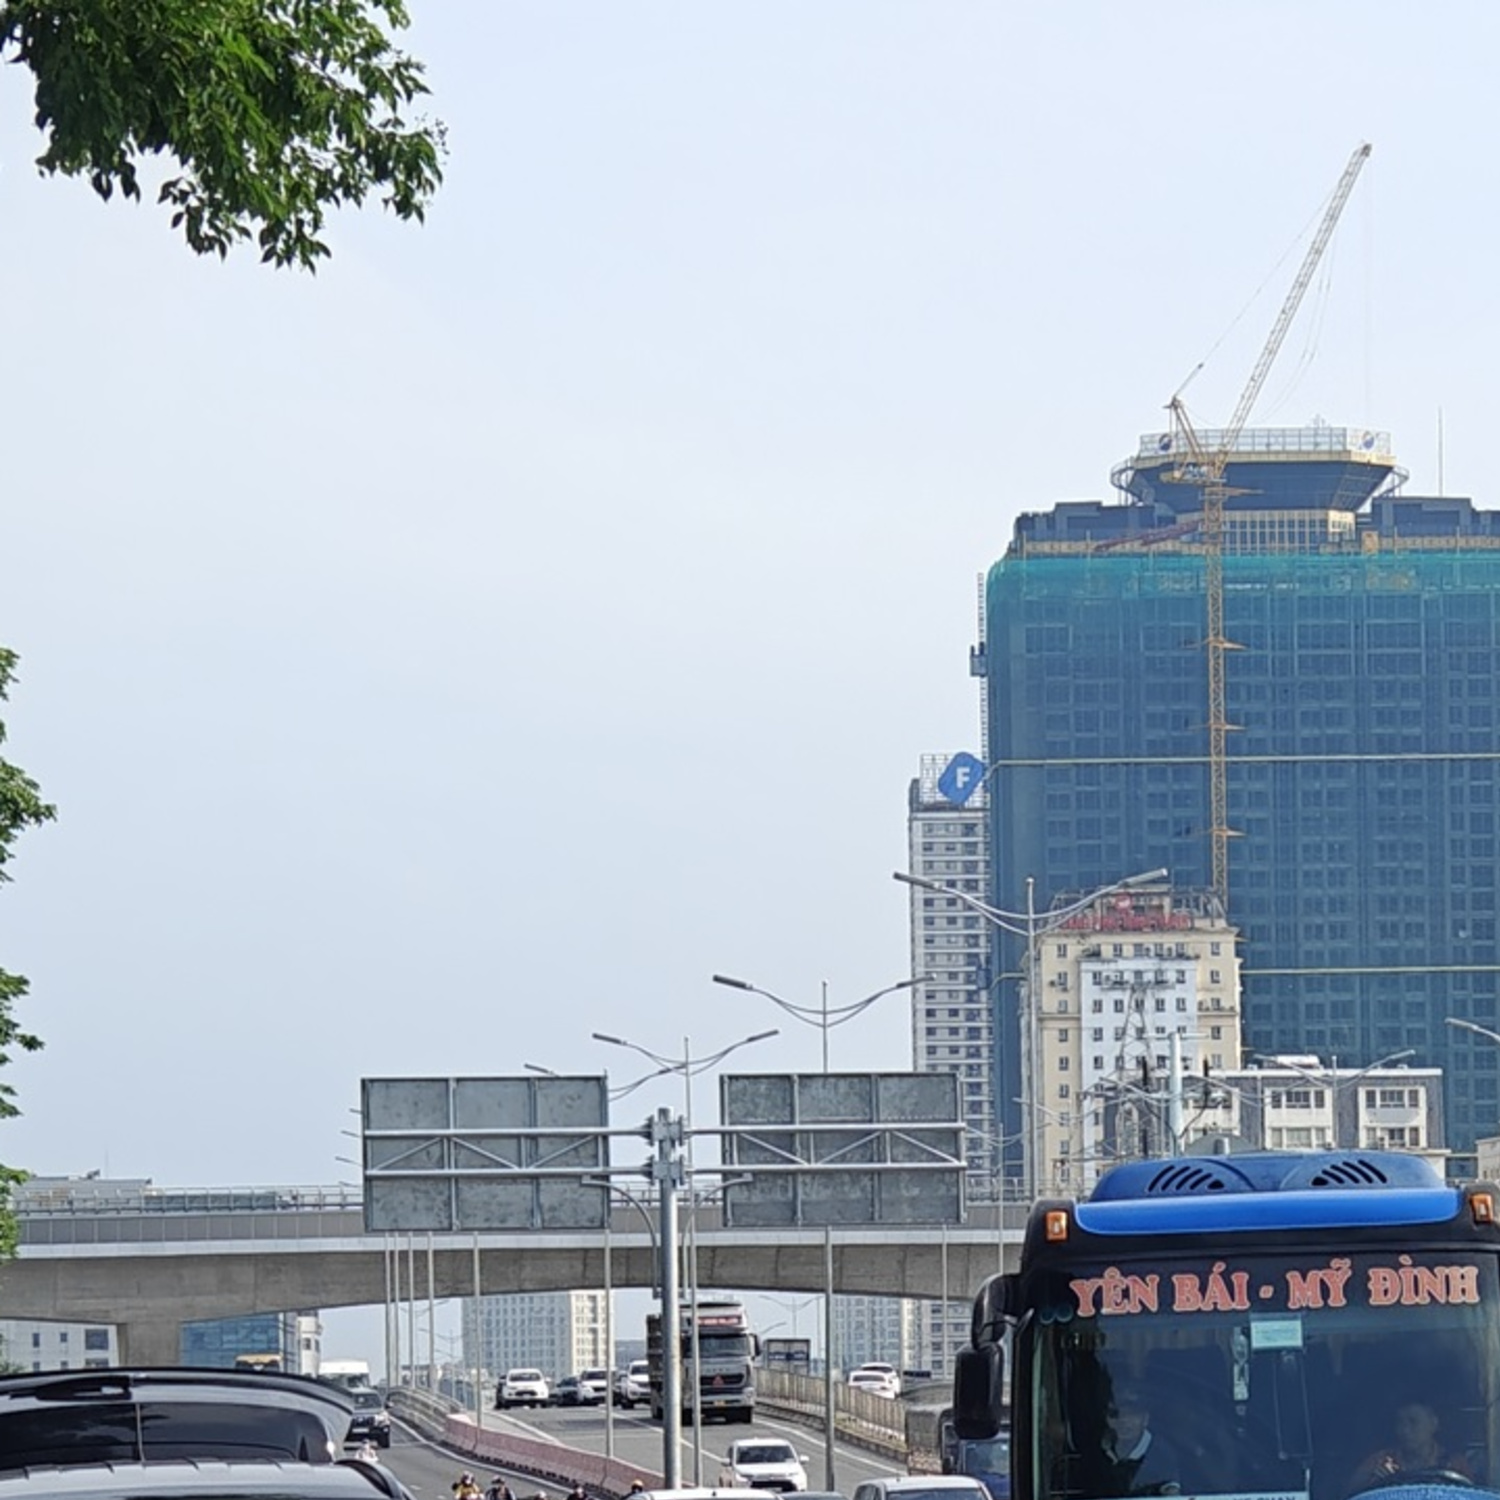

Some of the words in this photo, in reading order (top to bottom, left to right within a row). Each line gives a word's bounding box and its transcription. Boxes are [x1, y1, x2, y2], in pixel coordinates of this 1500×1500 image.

[956, 766, 970, 789] F
[1070, 1266, 1159, 1317] YÊN
[1171, 1261, 1251, 1312] BÁI
[1286, 1257, 1353, 1309] MỸ
[1367, 1254, 1481, 1307] ĐÌNH
